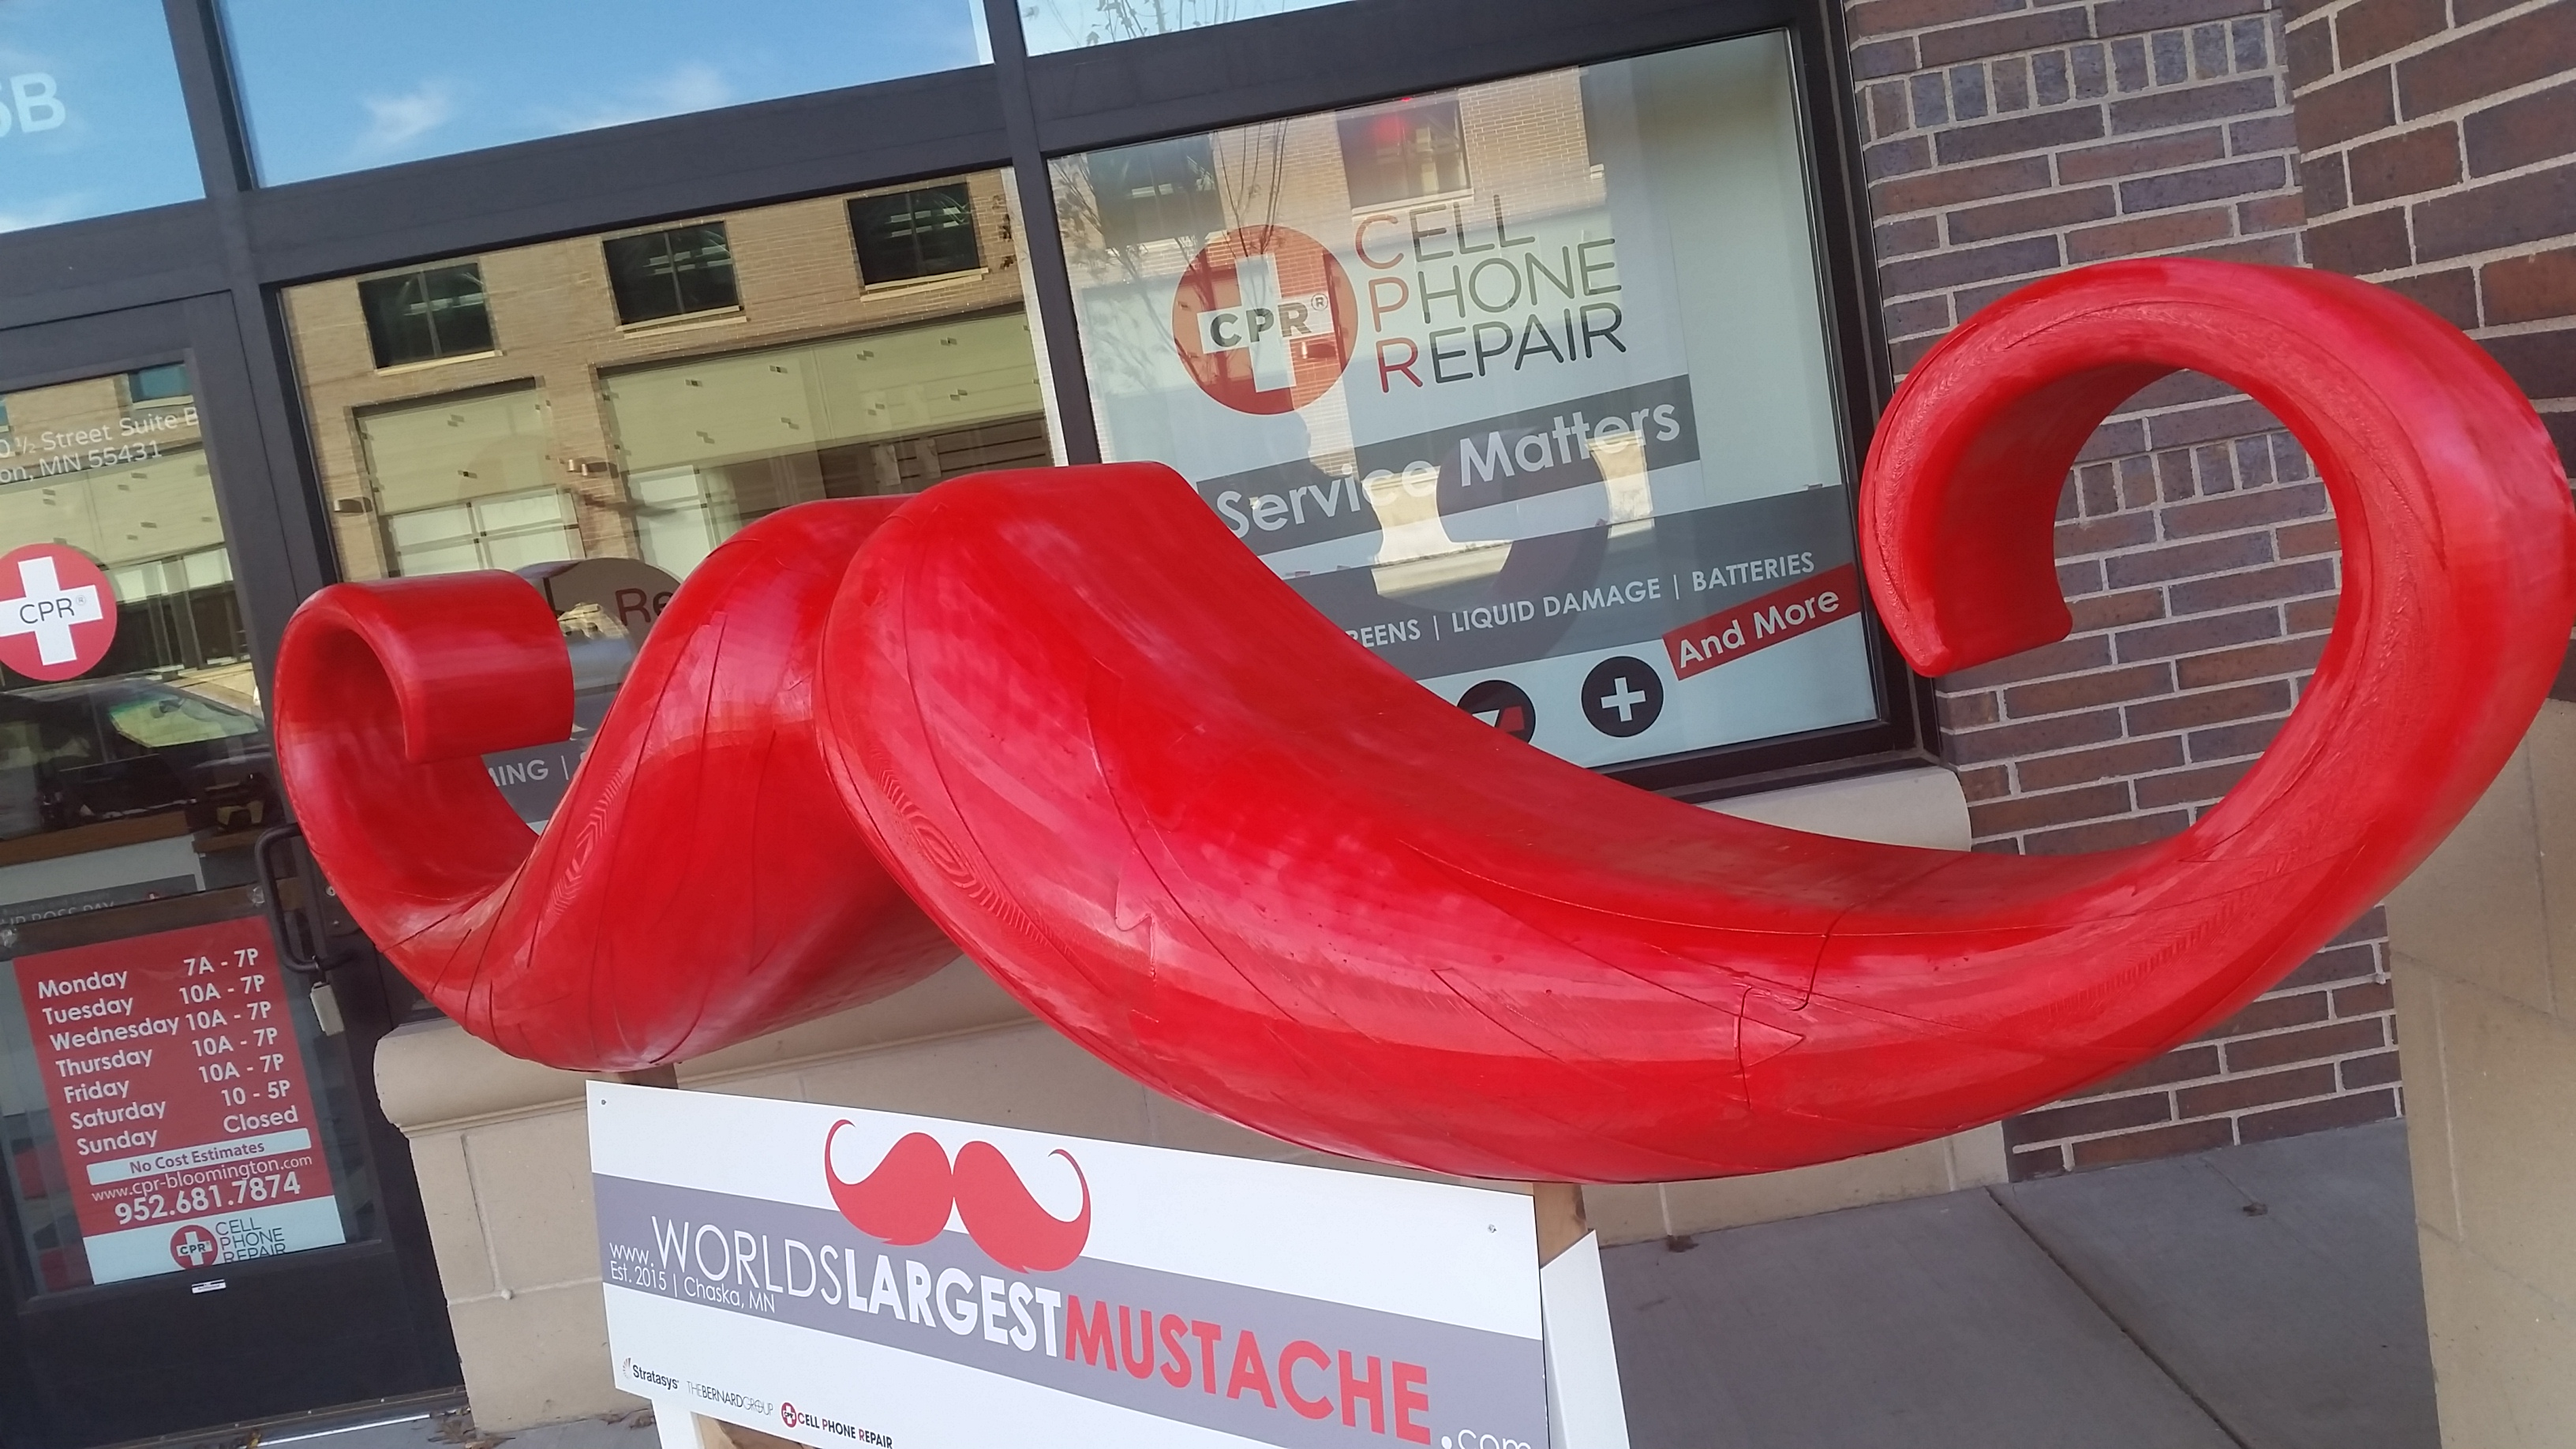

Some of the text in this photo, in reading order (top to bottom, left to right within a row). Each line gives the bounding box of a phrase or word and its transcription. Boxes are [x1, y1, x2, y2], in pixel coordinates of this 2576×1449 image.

[0, 73, 66, 137] B
[1355, 195, 1535, 271] CELL
[1368, 238, 1622, 333] PHONE
[1375, 301, 1627, 393] REPAIR
[41, 425, 113, 451] Street
[119, 414, 178, 436] Suite
[39, 453, 81, 477] MN
[88, 440, 163, 469] 55431
[1217, 403, 1681, 539] Service Matters
[1452, 601, 1535, 632] LIQUID
[1543, 578, 1661, 617] DAMAGE
[1691, 552, 1815, 593] BATTERIES
[1679, 590, 1840, 668] And More
[38, 971, 128, 999] Monday
[183, 957, 215, 976] 7A
[234, 948, 258, 968] 7P
[42, 998, 133, 1024] Tuesday
[178, 983, 221, 1005] 10A
[240, 975, 264, 994] 7P
[50, 1017, 179, 1050] Wednesday
[185, 1009, 227, 1031] 10A
[247, 1001, 271, 1020] 7P
[55, 1049, 152, 1077] Thursday
[192, 1035, 234, 1057] 10A
[253, 1028, 278, 1046] 7P
[63, 1080, 129, 1103] Friday
[198, 1061, 240, 1083] 10A
[260, 1054, 284, 1073] 7P
[69, 1101, 166, 1129] Saturday
[221, 1087, 246, 1106] 10
[268, 1080, 290, 1099] 5P
[77, 1105, 299, 1155] Sunday Closed
[92, 1156, 313, 1201] www.cpr-bloomington.com
[129, 1142, 264, 1174] No Cost Estimates
[115, 1171, 301, 1224] 952.681.7874
[215, 1217, 261, 1236] CELL
[220, 1227, 285, 1251] PHONE
[223, 1243, 286, 1263] REPAIR
[610, 1260, 632, 1283] Est.
[635, 1266, 667, 1291] 2015
[683, 1276, 745, 1309] Chaska,
[750, 1290, 776, 1313] MN
[797, 1413, 893, 1449] CELL PHONE REPAIR
